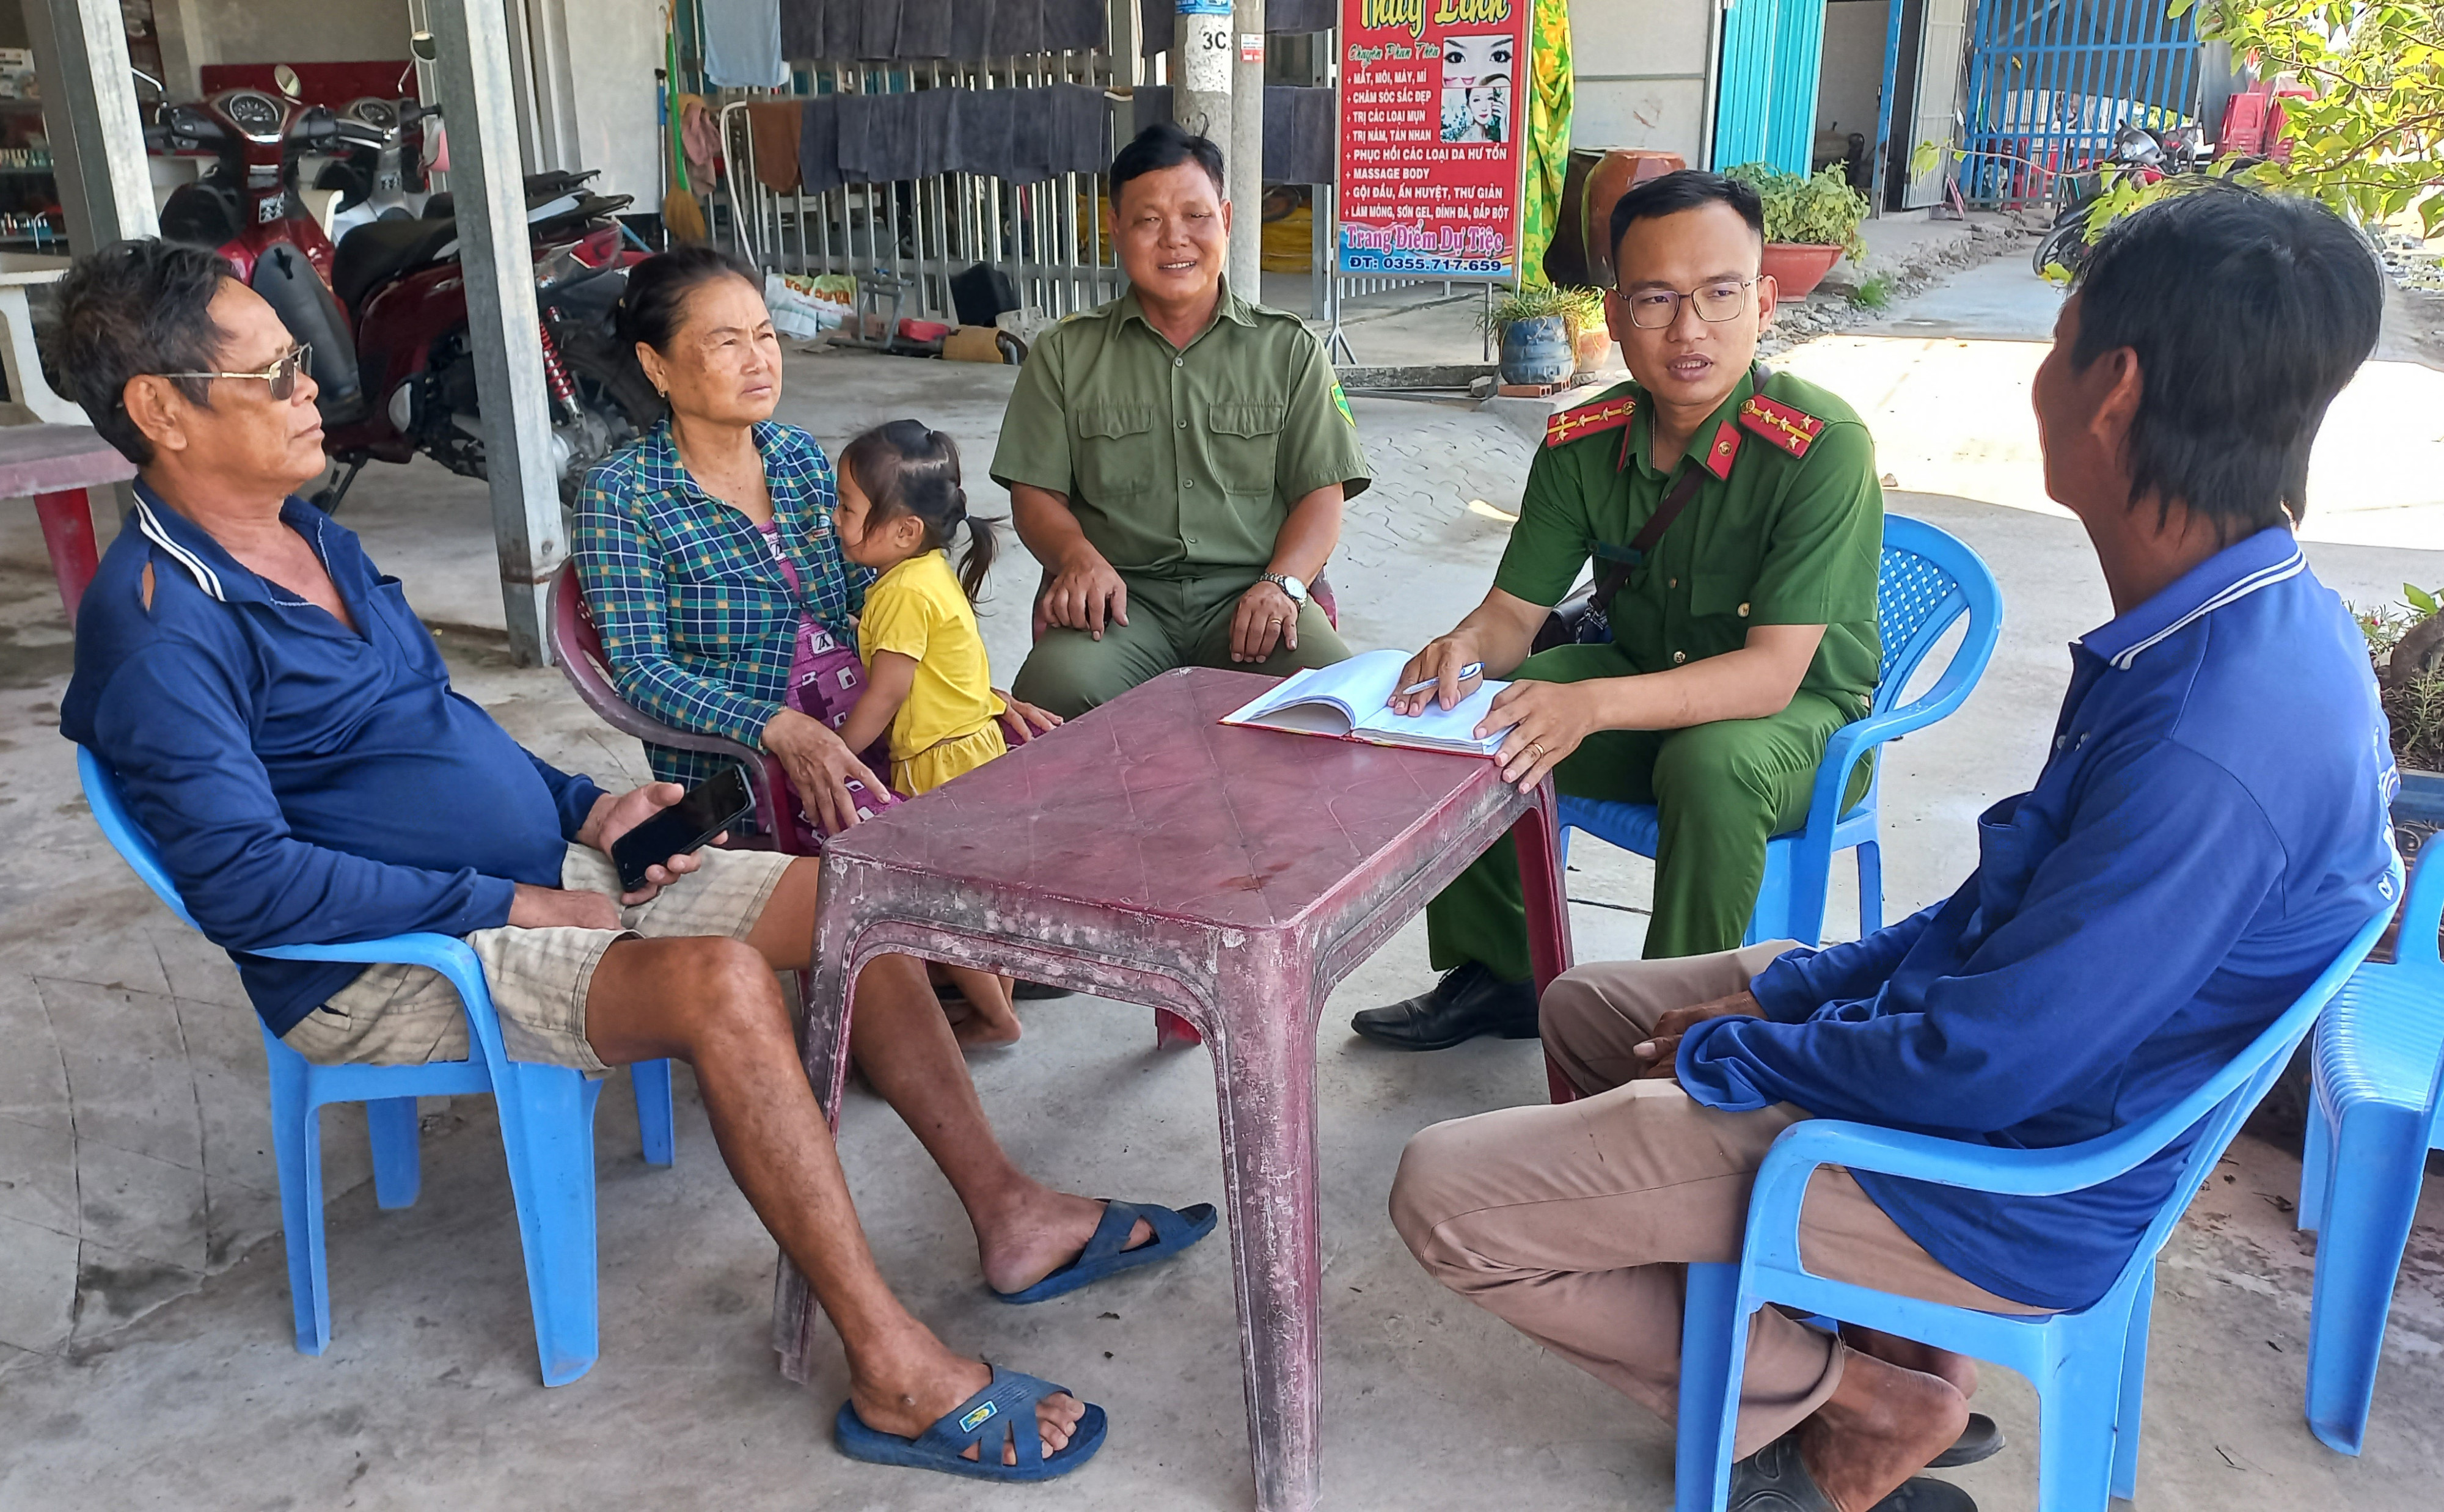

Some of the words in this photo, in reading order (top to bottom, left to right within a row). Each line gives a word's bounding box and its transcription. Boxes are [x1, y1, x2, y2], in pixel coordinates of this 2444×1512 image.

[1385, 42, 1412, 60] Phun
[1353, 89, 1377, 104] CHĂM
[1378, 88, 1395, 103] SÓC
[1414, 90, 1432, 106] ĐẸP
[1353, 111, 1366, 126] TRỊ
[1367, 107, 1385, 123] CÁC
[1386, 110, 1406, 126] LOẠI
[1407, 109, 1426, 125] MỤN
[1352, 130, 1366, 145] TRỊ
[1408, 129, 1432, 142] NHAN
[1353, 149, 1381, 164] PHỤC
[1402, 145, 1424, 161] CÁC
[1425, 148, 1449, 164] LOẠI
[1451, 148, 1466, 160] DA
[1467, 145, 1484, 160] HƯ
[1485, 142, 1507, 160] TỔN
[1353, 167, 1400, 179] MASSAGE
[1402, 167, 1430, 180] BODY
[1353, 184, 1370, 201] GỘI
[1397, 182, 1413, 199] ẤN
[1414, 184, 1451, 202] HUYỆT,
[1454, 184, 1476, 199] THƯ
[1351, 202, 1368, 218] LÀM
[1397, 204, 1414, 218] SƠN
[1415, 206, 1433, 221] GEL,
[1435, 203, 1456, 219] ĐÍNH
[1491, 204, 1510, 223] BỘT
[1346, 225, 1392, 254] Trang
[1394, 219, 1436, 251] Điểm
[1440, 225, 1466, 256] Dự
[1468, 225, 1504, 257] Tiệc
[1350, 257, 1378, 269] ĐT:
[1383, 257, 1502, 272] 0355.717.659
